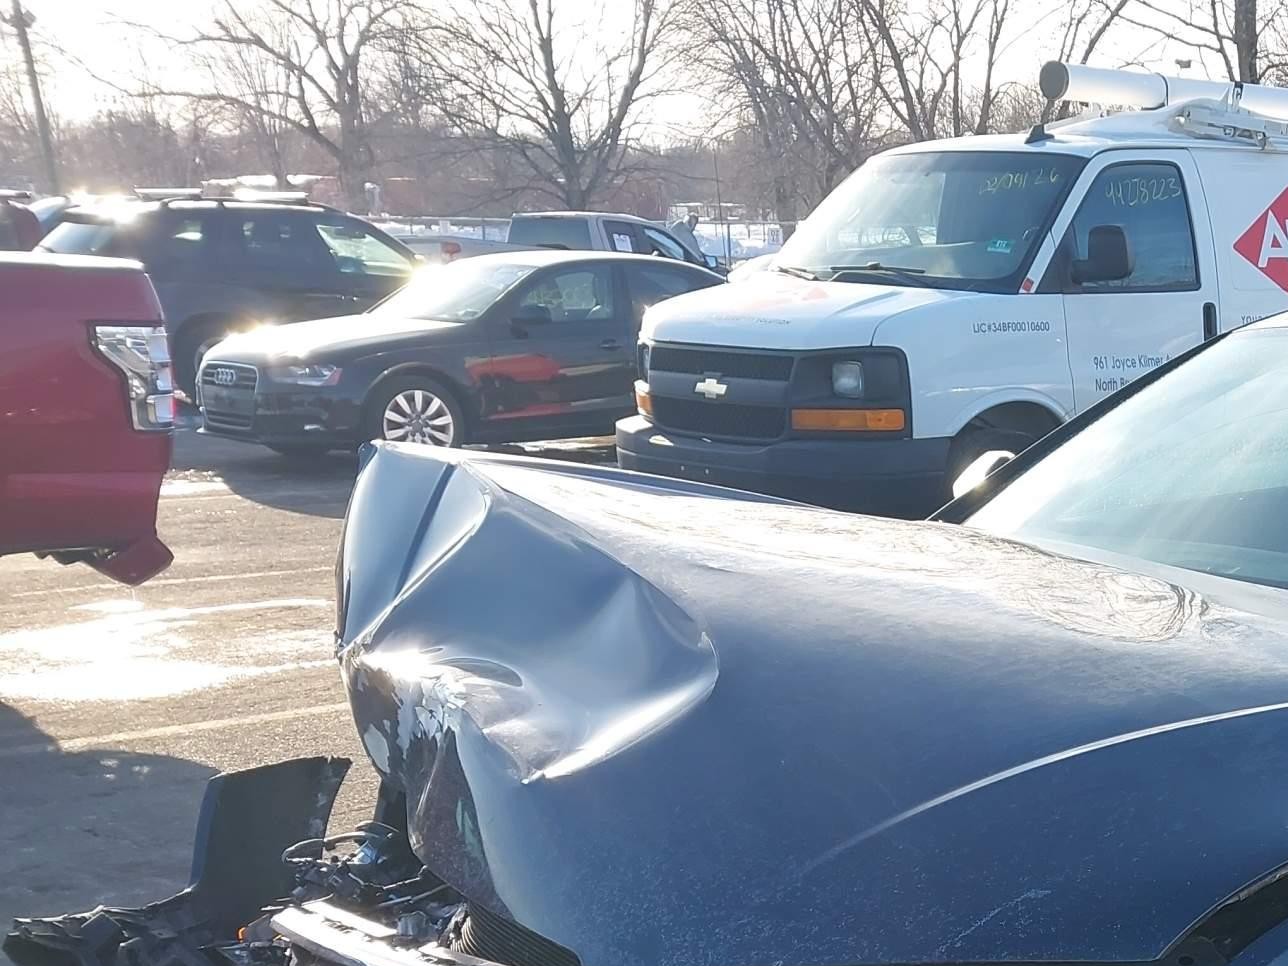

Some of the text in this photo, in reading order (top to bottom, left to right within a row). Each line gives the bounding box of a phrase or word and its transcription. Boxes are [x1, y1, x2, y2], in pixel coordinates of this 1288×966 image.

[1093, 356, 1108, 370] 961
[1111, 355, 1137, 373] Joyce
[1095, 378, 1118, 392] North
